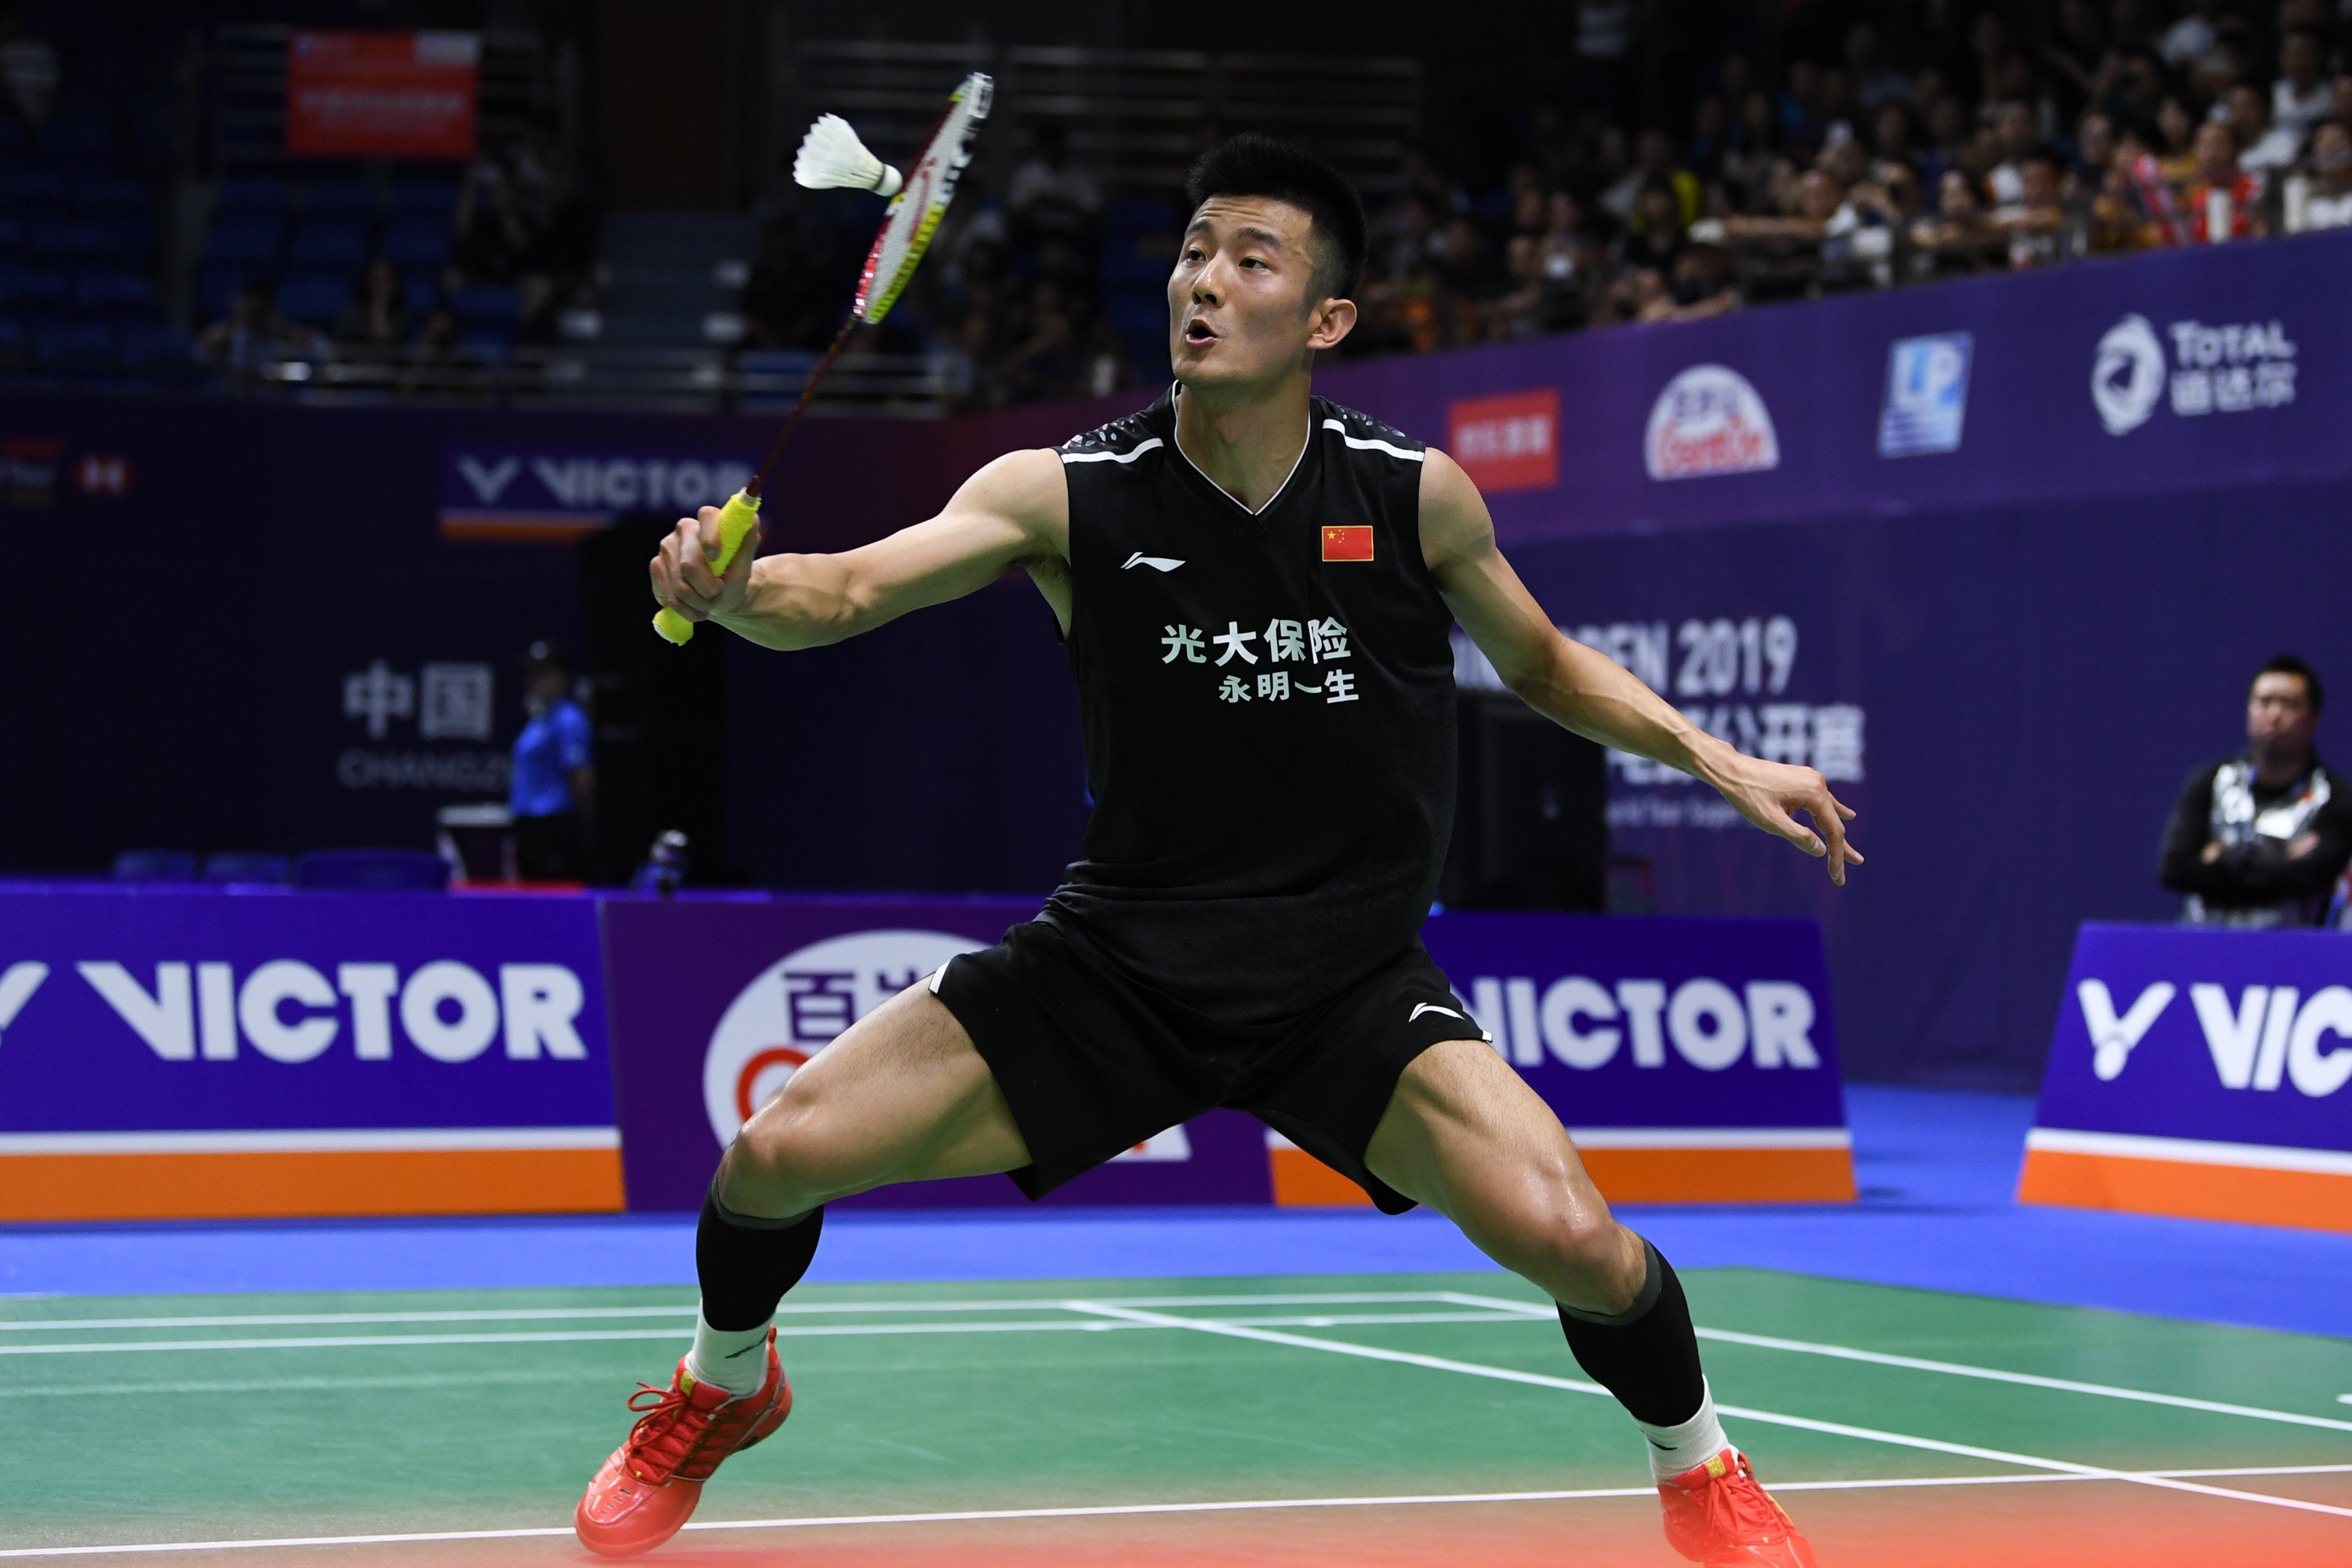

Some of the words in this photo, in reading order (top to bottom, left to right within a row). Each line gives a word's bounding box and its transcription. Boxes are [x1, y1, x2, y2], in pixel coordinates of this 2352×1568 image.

[2167, 318, 2297, 367] TOTAL
[1161, 615, 1352, 667] 光大保险
[1675, 615, 1799, 698] 2019
[341, 657, 495, 742] 中国
[1218, 669, 1359, 704] 永明一生
[74, 959, 589, 1063] VICTOR
[2190, 982, 2352, 1098] VIC
